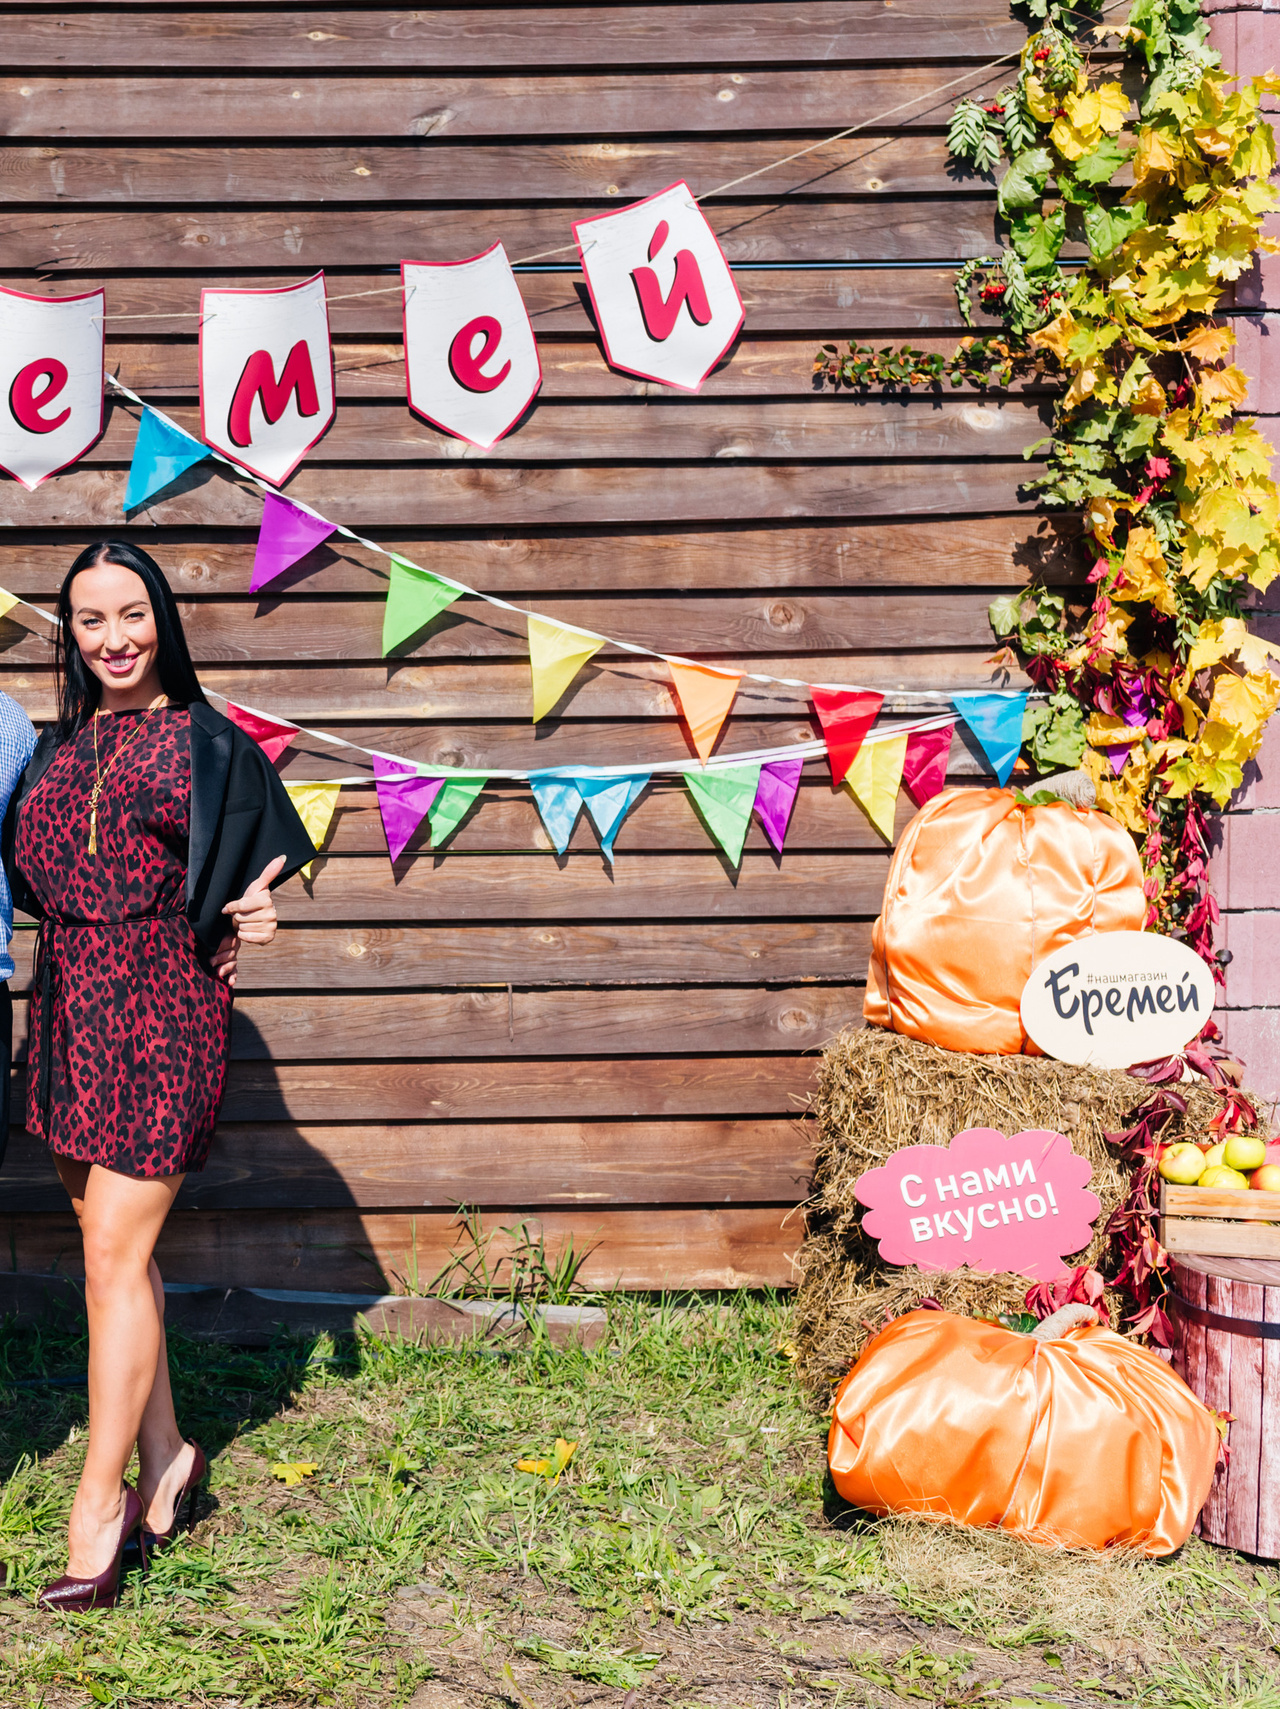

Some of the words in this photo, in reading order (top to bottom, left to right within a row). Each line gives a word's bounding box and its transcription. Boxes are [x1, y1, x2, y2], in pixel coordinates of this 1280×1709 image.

[1044, 962, 1199, 1035] Еремей
[1086, 971, 1168, 985] #нашмагазин
[899, 1174, 927, 1207] С
[934, 1159, 1037, 1202] нами
[909, 1182, 1059, 1243] вкусно!
